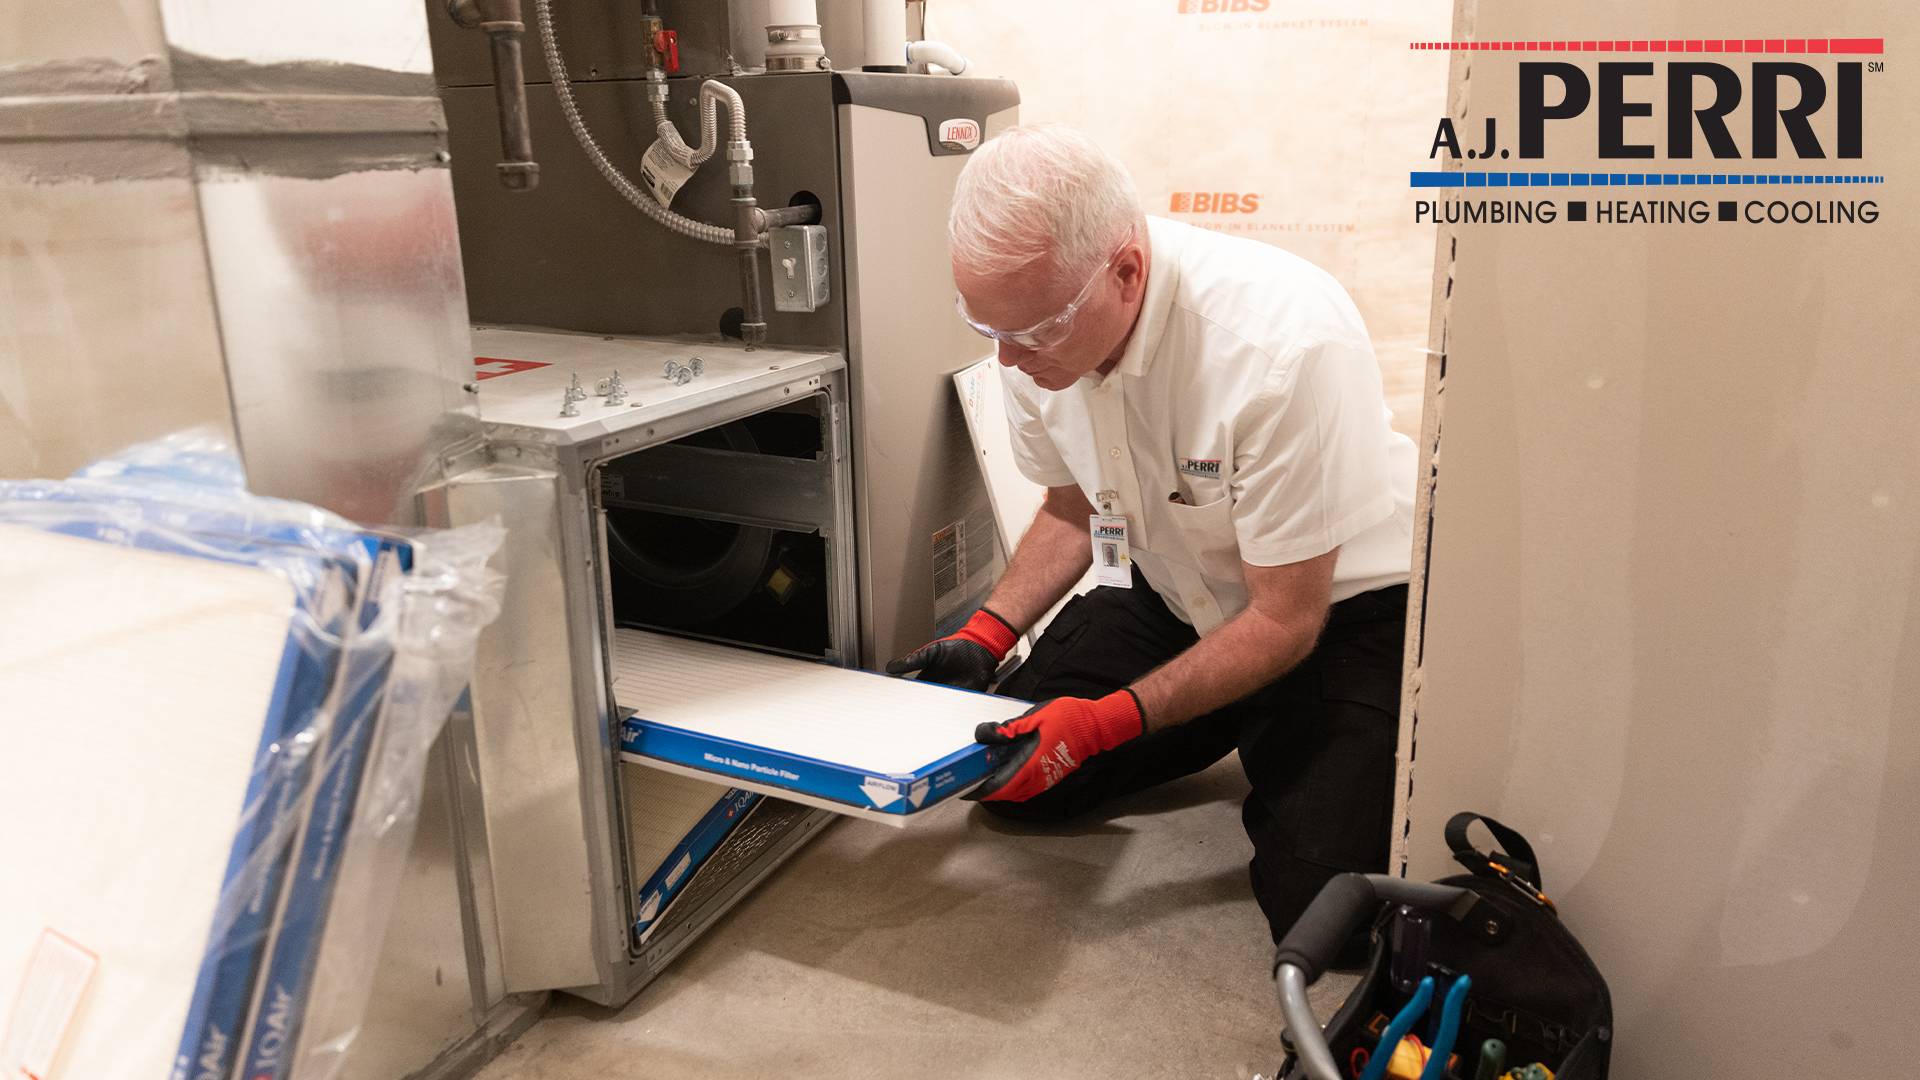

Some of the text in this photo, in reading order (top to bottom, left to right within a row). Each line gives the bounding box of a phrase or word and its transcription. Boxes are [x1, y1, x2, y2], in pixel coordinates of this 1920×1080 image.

[1192, 192, 1260, 214] BIBS
[1187, 460, 1220, 473] PERRI
[1100, 526, 1124, 536] PERRI
